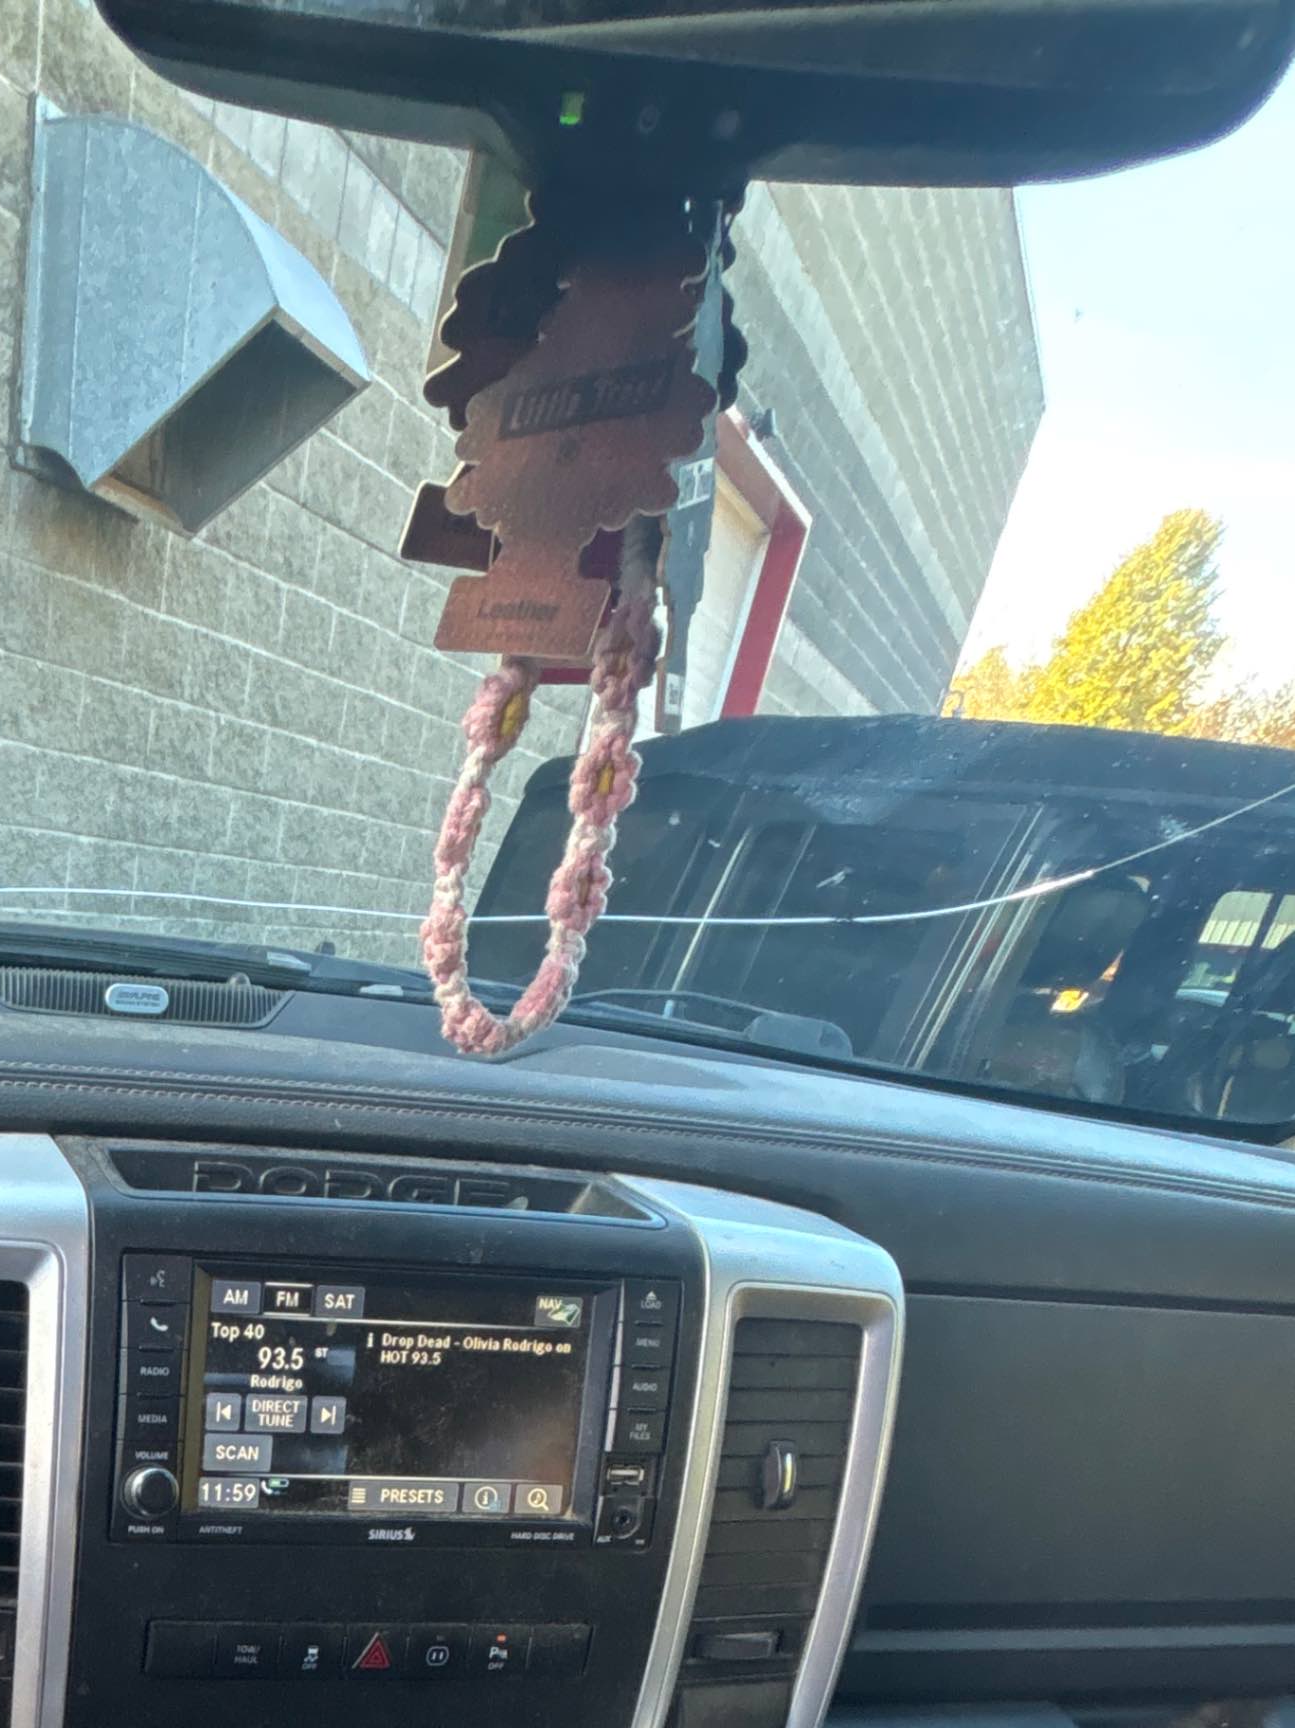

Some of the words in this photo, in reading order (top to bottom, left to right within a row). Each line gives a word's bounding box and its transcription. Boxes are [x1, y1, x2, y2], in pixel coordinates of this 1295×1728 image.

[223, 1289, 249, 1306] AM
[276, 1291, 300, 1307] FM
[324, 1293, 355, 1310] SAT
[538, 1298, 562, 1310] NAV
[211, 1322, 241, 1343] Top
[243, 1324, 265, 1340] 40
[381, 1333, 415, 1350] Drop
[417, 1334, 451, 1349] Dead
[463, 1336, 500, 1351] Olivia
[502, 1338, 553, 1355] Rodrigo
[555, 1342, 572, 1353] on
[258, 1347, 304, 1370] 93.5
[380, 1351, 409, 1365] HOT
[411, 1352, 442, 1366] 93.5
[140, 1367, 170, 1377] RADIO
[250, 1374, 303, 1392] Rodrigo
[252, 1398, 301, 1413] DIRECT
[137, 1414, 167, 1424] MEDIA
[258, 1413, 295, 1428] TUNE
[135, 1451, 169, 1460] VOLUME
[215, 1445, 260, 1461] SCAN
[201, 1482, 256, 1502] 11:59
[380, 1488, 444, 1504] PRESETS
[368, 1529, 404, 1541] SIRIUS
